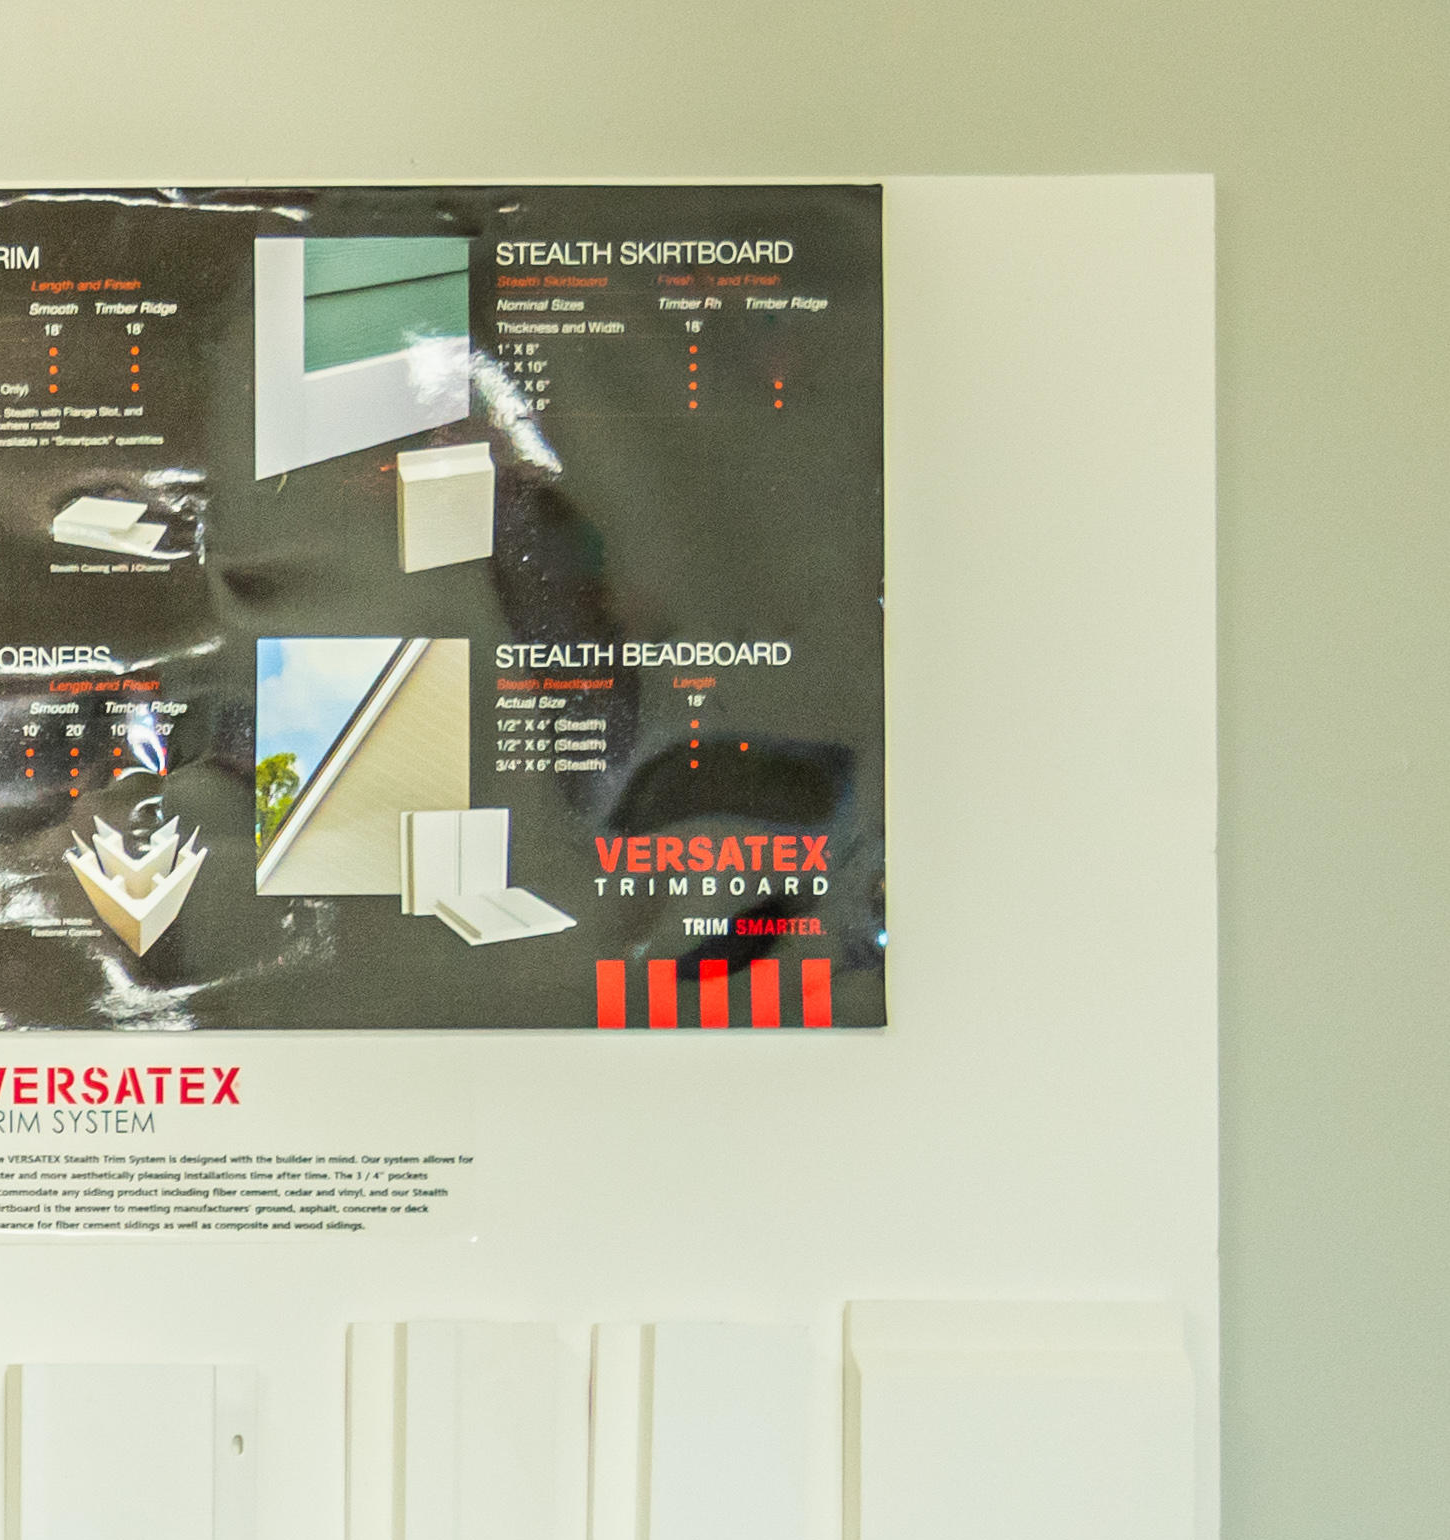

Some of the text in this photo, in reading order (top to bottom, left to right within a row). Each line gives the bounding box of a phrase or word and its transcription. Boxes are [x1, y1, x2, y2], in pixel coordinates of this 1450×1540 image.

[496, 241, 793, 266] STEALTH SKIRTBOARD
[29, 304, 79, 316] Smooth
[95, 303, 137, 315] Timber
[140, 302, 177, 315] Ridge
[497, 322, 558, 335] Thickness
[561, 322, 587, 335] and
[591, 322, 625, 335] Width
[495, 643, 791, 669] STEALTH BEADBOARD
[496, 697, 535, 710] Actual
[538, 697, 566, 709] Size
[595, 836, 828, 872] VERSATEX
[595, 878, 829, 897] TRIMBOARD
[683, 918, 826, 936] TRIM SMARTER.
[52, 1110, 155, 1134] SYSTEM
